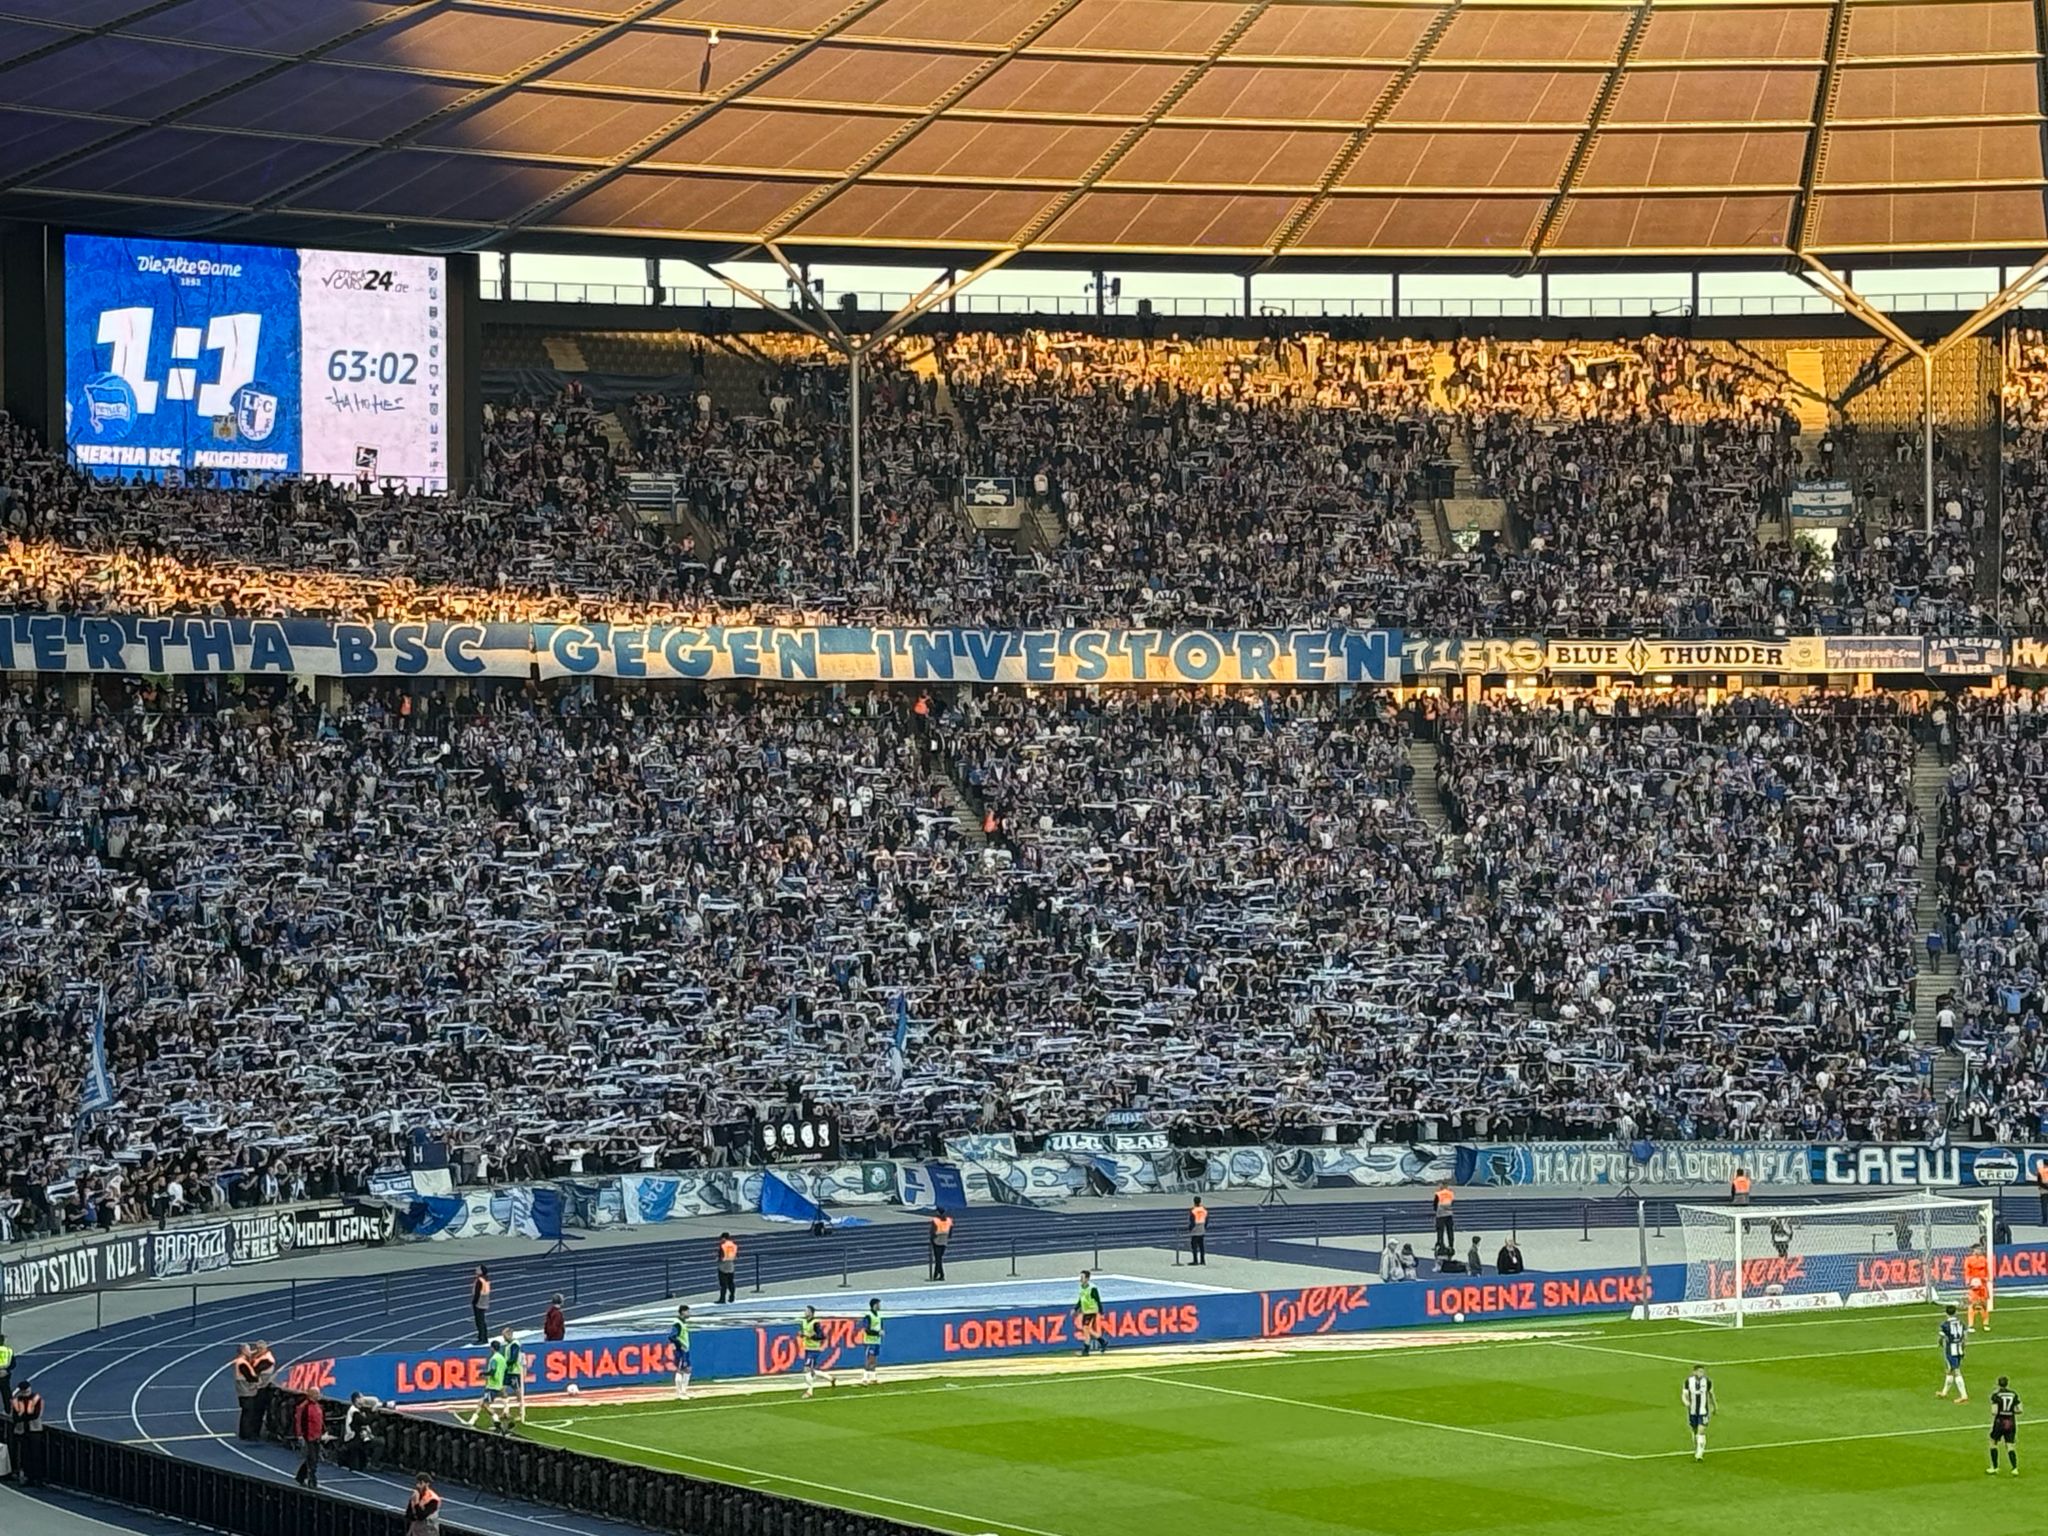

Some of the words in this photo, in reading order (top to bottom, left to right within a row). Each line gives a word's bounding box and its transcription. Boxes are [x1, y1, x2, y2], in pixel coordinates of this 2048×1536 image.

[328, 349, 419, 385] 63:02
[76, 445, 146, 465] HERTHA
[148, 448, 182, 467] BSC
[333, 621, 487, 677] BSC
[545, 621, 820, 681] GEGEN
[871, 628, 1391, 683] INVESTOREN
[1401, 637, 1547, 674] 71ERS
[1555, 647, 1619, 665] BLUE
[1660, 646, 1783, 666] THUNDER
[1826, 1147, 1961, 1185] CREW
[1978, 1169, 2015, 1180] CREW
[231, 1217, 278, 1240] YOUNG
[296, 1216, 381, 1247] HOOLIGANS
[3, 1247, 98, 1296] HAUPTSTADT
[106, 1237, 147, 1281] KULT
[1426, 1282, 1536, 1316] LORENZ
[1543, 1275, 1653, 1307] SNACKS
[944, 1313, 1067, 1352] LORENZ
[1073, 1304, 1199, 1340] SNACKS
[397, 1353, 537, 1394] LOREZ
[2001, 1396, 2013, 1411] 17
